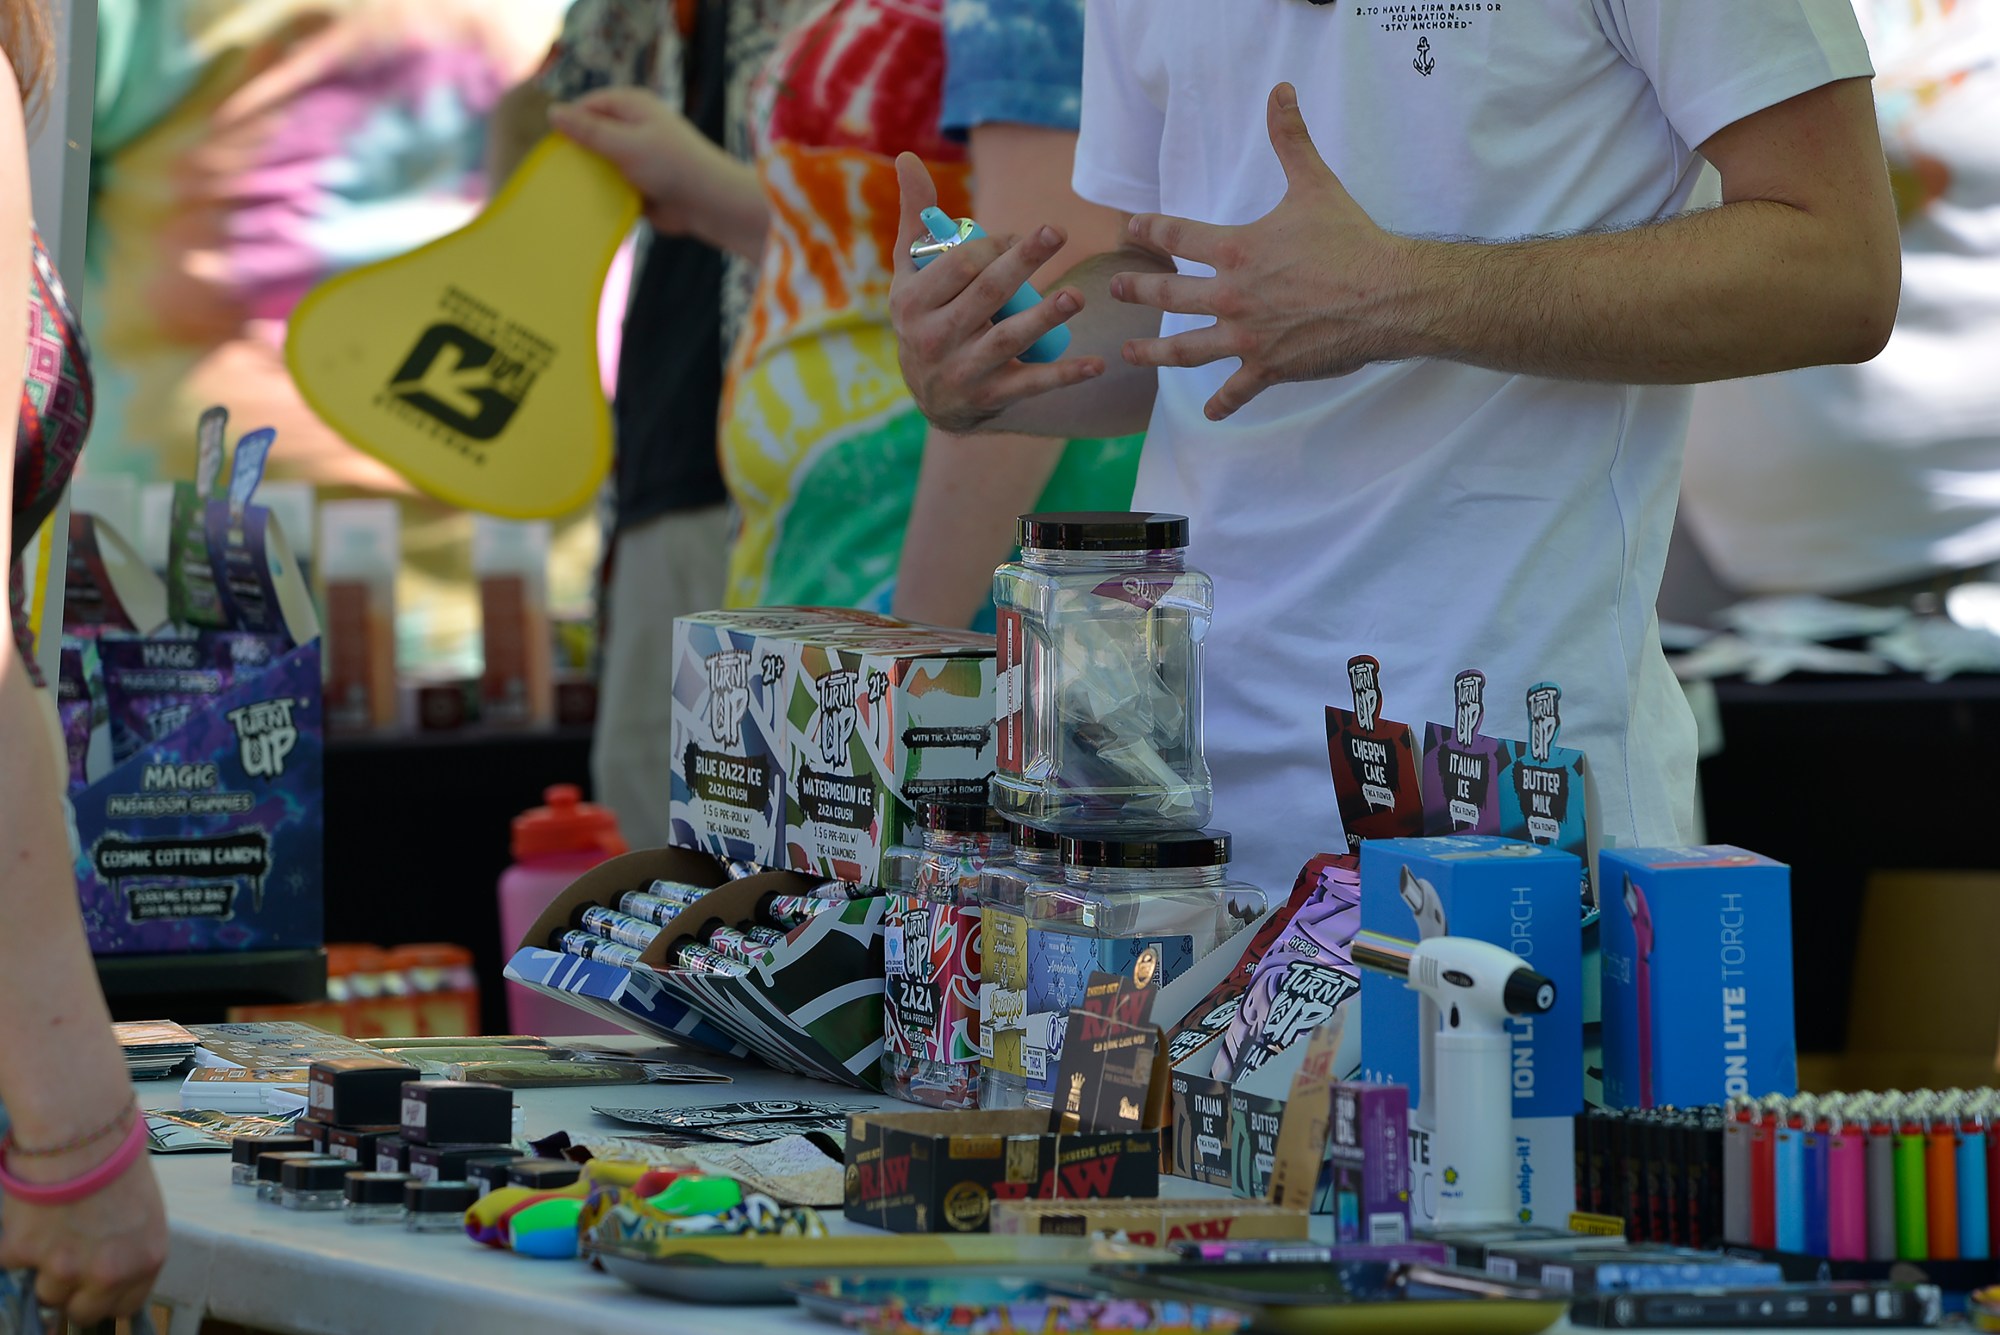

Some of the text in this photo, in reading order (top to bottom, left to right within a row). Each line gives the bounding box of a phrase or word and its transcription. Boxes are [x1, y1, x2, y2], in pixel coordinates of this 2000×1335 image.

[1382, 6, 1406, 14] HAVE
[1410, 5, 1416, 13] A
[1421, 3, 1444, 12] FIRM
[1450, 3, 1482, 11] BASIS
[1487, 3, 1501, 11] OR
[1392, 12, 1459, 22] FOUNDATION.
[143, 645, 195, 665] MAGIC
[705, 650, 751, 692] TURNT
[762, 655, 785, 687] 21+
[1349, 662, 1375, 690] TURNT
[815, 670, 859, 711] TURNT
[867, 671, 890, 704] 21+
[1456, 675, 1483, 703] TURNT
[711, 687, 750, 747] UP
[1355, 688, 1378, 731] UP
[1528, 688, 1557, 719] TURNT
[227, 698, 295, 738] TURNT
[1457, 702, 1480, 745] UP
[821, 706, 858, 769] UP
[912, 732, 981, 743] WITH THC-A DIAMOND
[1351, 738, 1387, 764] CHERRY
[1531, 716, 1556, 759] UP
[241, 727, 297, 777] UP
[143, 763, 217, 790] MAGIC
[695, 754, 762, 787] BLUE RAZZ ICE
[1364, 763, 1387, 785] CAKE
[1449, 752, 1482, 780] ITALIAN
[708, 784, 748, 803] ZAZA CRUSH
[802, 776, 871, 807] WATERMELON ICE
[907, 784, 983, 795] PREMIUM THC-A FLOWER
[1365, 787, 1392, 801] THCA FLOWER
[1457, 780, 1470, 799] ICE
[1522, 768, 1560, 795] BUTTER
[110, 793, 250, 816] MUSHROOM GUMMIES
[720, 808, 743, 823] PRE-ROLL
[817, 802, 854, 822] ZAZA CRUSH
[1452, 804, 1477, 818] THCA FLOWER
[1532, 795, 1551, 816] MILK
[706, 820, 750, 840] THC-A DIAMONDS
[828, 830, 849, 844] PRE-ROLL
[1531, 820, 1557, 834] THCA FLOWER
[101, 846, 263, 868] COSMIC COTTON CANDY
[816, 843, 857, 861] THC-A DIAMONDS
[902, 911, 930, 938] TURNT
[1511, 887, 1534, 958] ORCH
[906, 936, 928, 976] UP
[1289, 935, 1319, 958] HYBRID
[900, 982, 933, 1013] ZAZA
[1284, 963, 1359, 1005] TURNT
[1720, 893, 1749, 1101] ON LITE TORCH
[901, 1010, 934, 1027] THCA PREROLLS
[1081, 989, 1150, 1040] RAW
[1263, 991, 1333, 1046] UP
[909, 1030, 926, 1043] HYBRID
[1029, 1056, 1041, 1071] THCA
[1515, 1046, 1535, 1098] ION
[1173, 1079, 1188, 1094] HYBRID
[1195, 1094, 1222, 1117] ITALIAN
[1203, 1116, 1214, 1134] ICE
[1251, 1112, 1279, 1136] BUTTER
[1258, 1134, 1273, 1154] MILK
[860, 1153, 911, 1200] RAW
[1516, 1136, 1534, 1204] whip-it!
[1127, 1215, 1237, 1248] RAW
